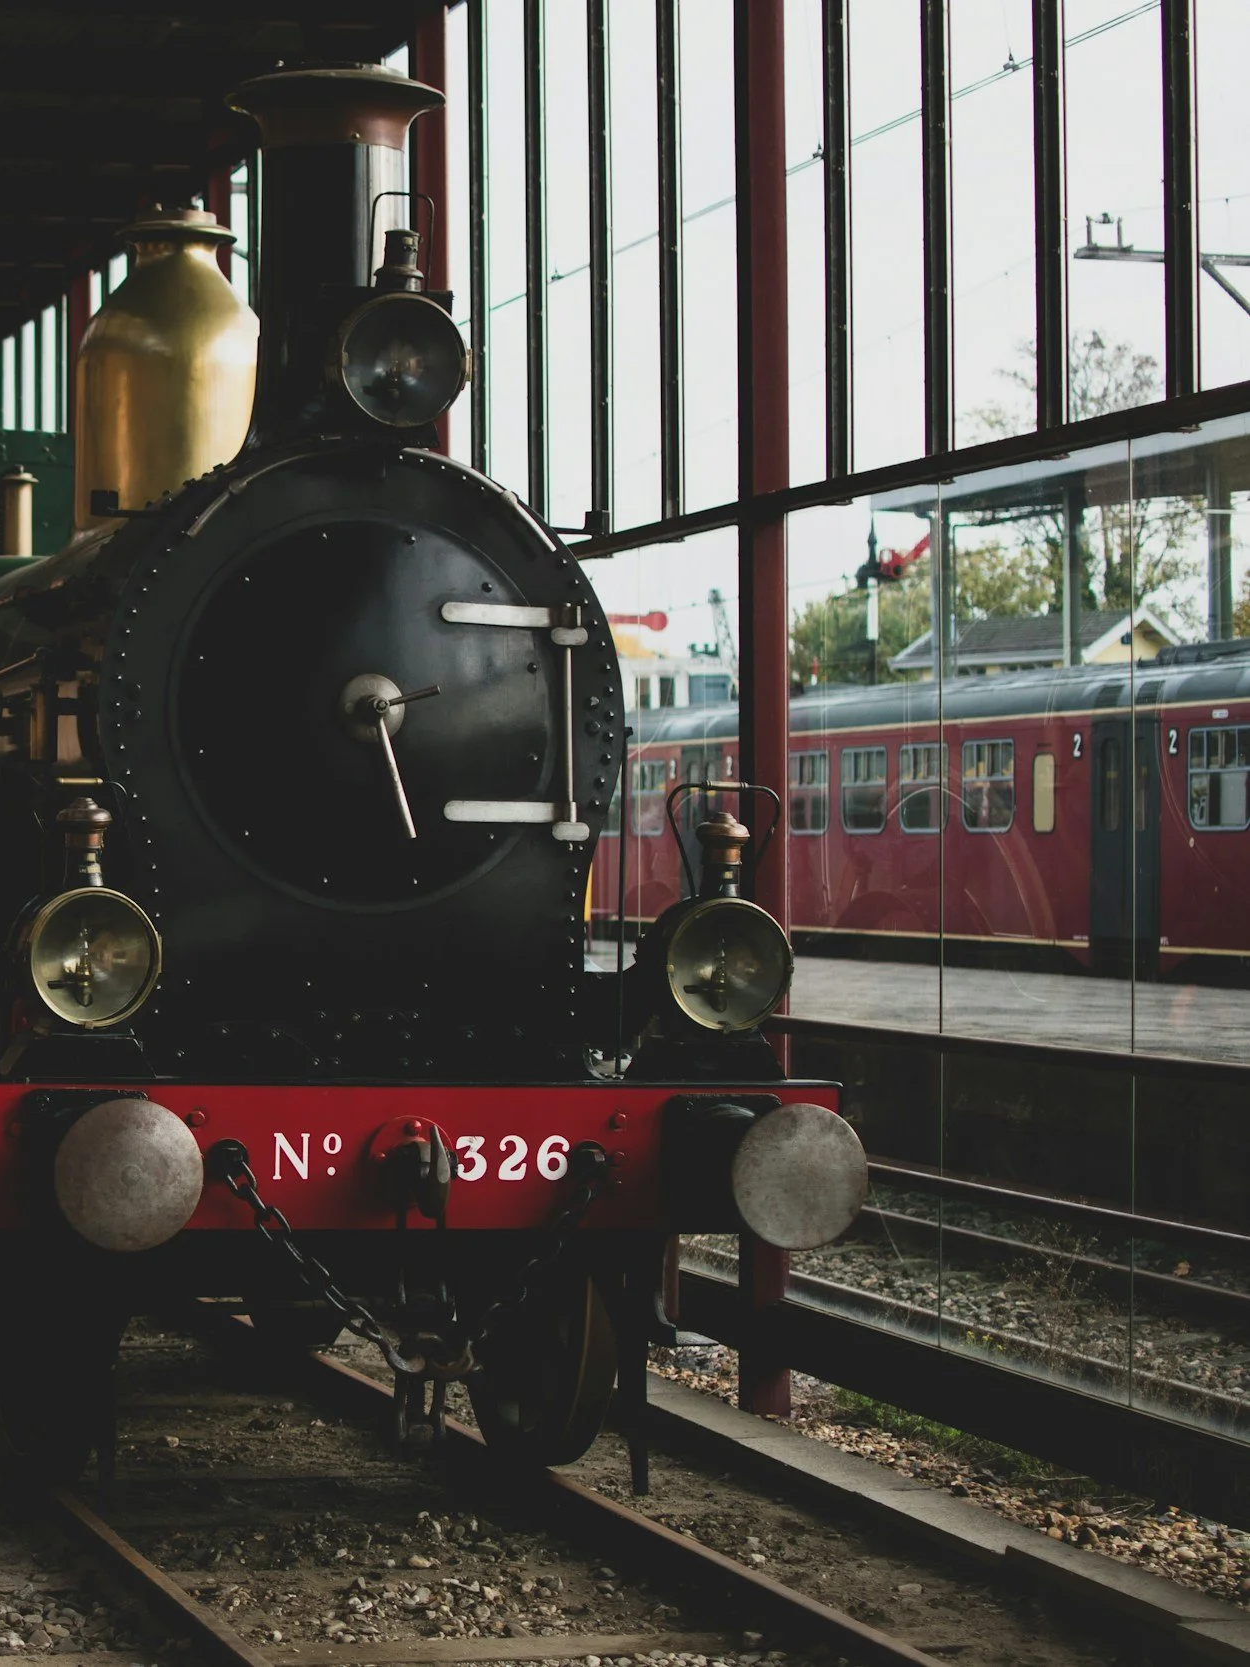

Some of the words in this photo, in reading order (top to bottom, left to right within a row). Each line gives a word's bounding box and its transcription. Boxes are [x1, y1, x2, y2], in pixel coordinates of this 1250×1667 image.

[1072, 733, 1082, 758] 2
[1168, 729, 1178, 754] 2
[455, 1134, 570, 1182] 326
